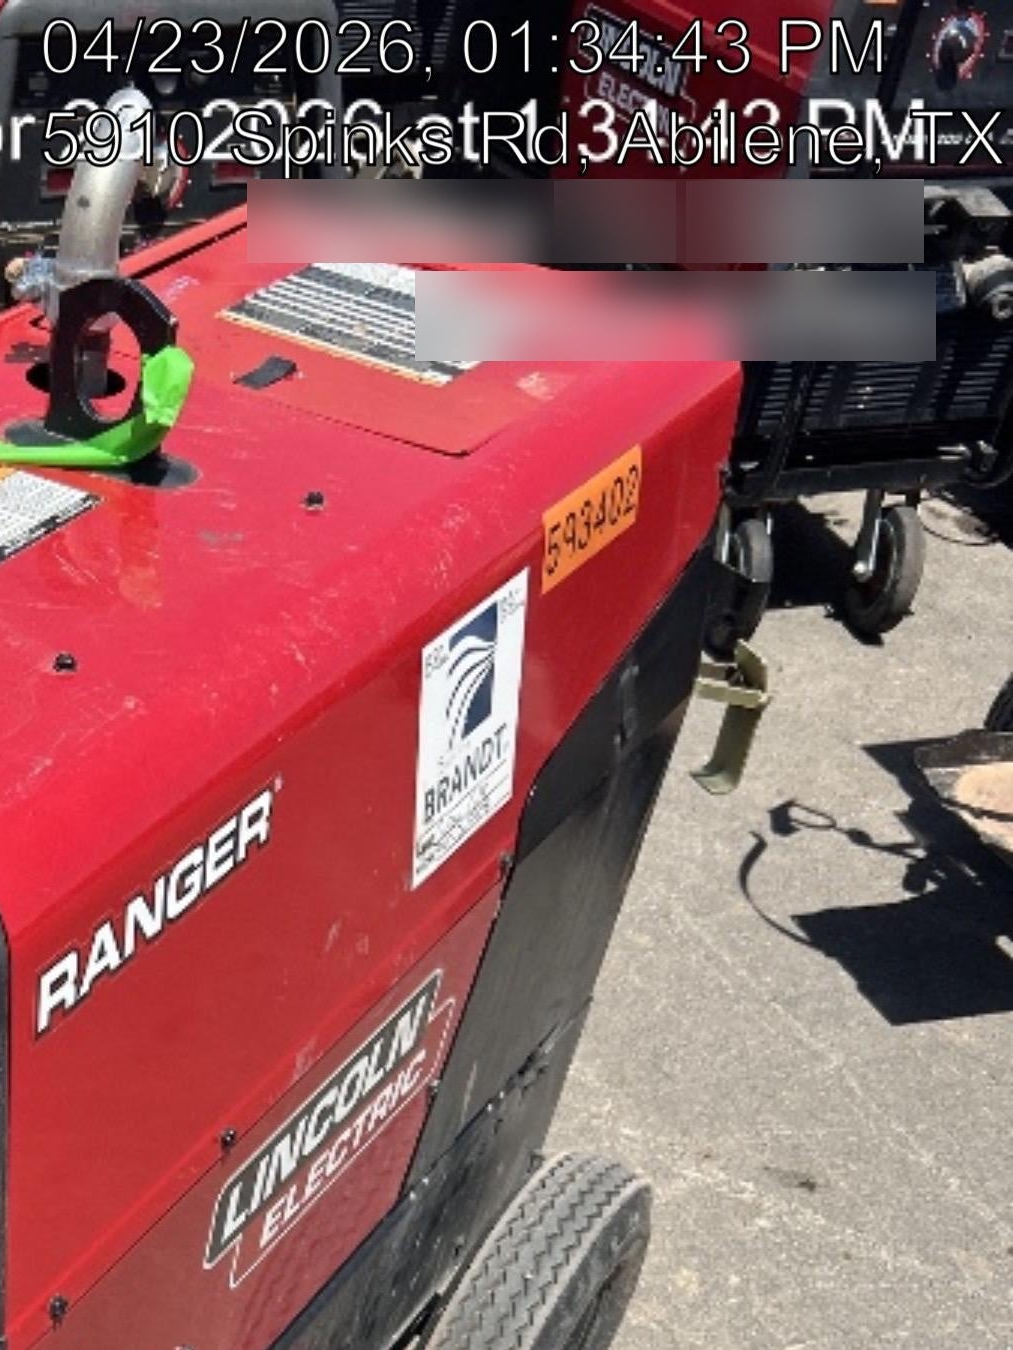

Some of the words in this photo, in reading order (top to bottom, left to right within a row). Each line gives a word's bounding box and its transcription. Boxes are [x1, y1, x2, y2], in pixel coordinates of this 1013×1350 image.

[546, 464, 639, 576] 593402
[424, 722, 507, 824] BRANDT
[36, 789, 275, 1035] RANGER
[221, 992, 429, 1242] LINCOLN
[259, 1048, 428, 1248] ELECTRIC
